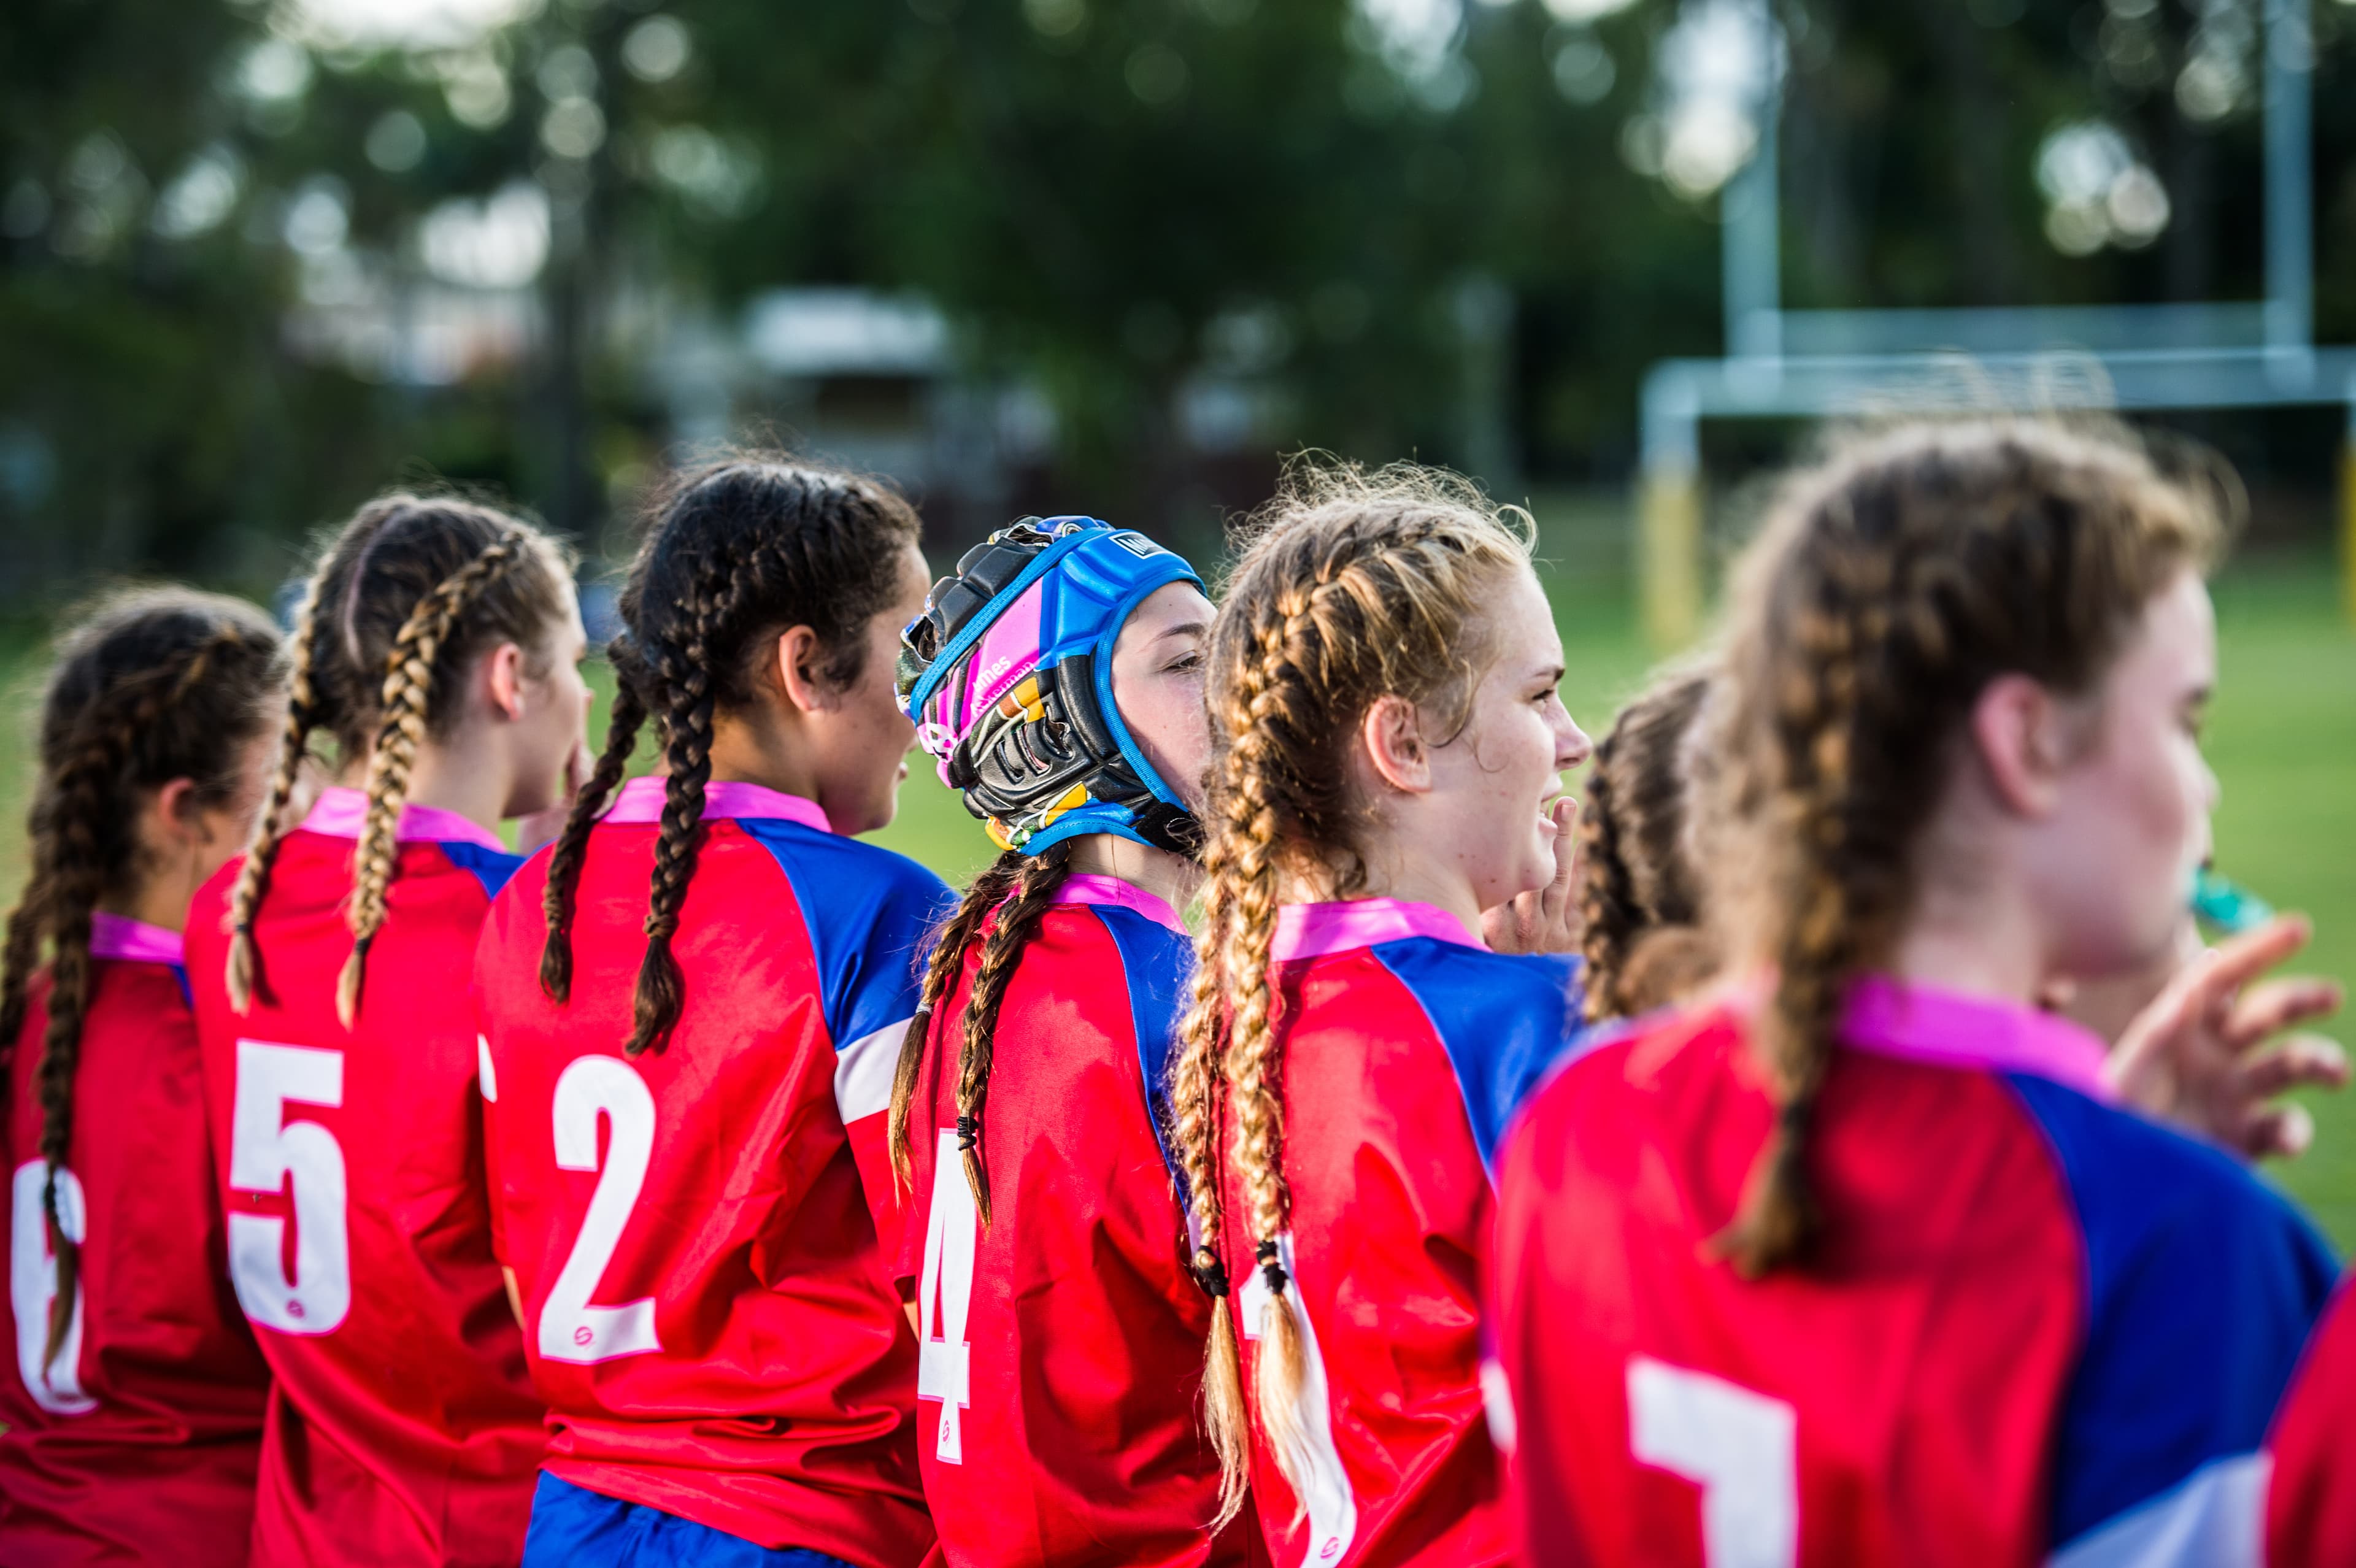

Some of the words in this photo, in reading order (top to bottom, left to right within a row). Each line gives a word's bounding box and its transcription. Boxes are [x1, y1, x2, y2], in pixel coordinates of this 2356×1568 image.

[227, 1037, 352, 1336] 5
[538, 1053, 664, 1366] 2
[917, 1127, 977, 1466] 4
